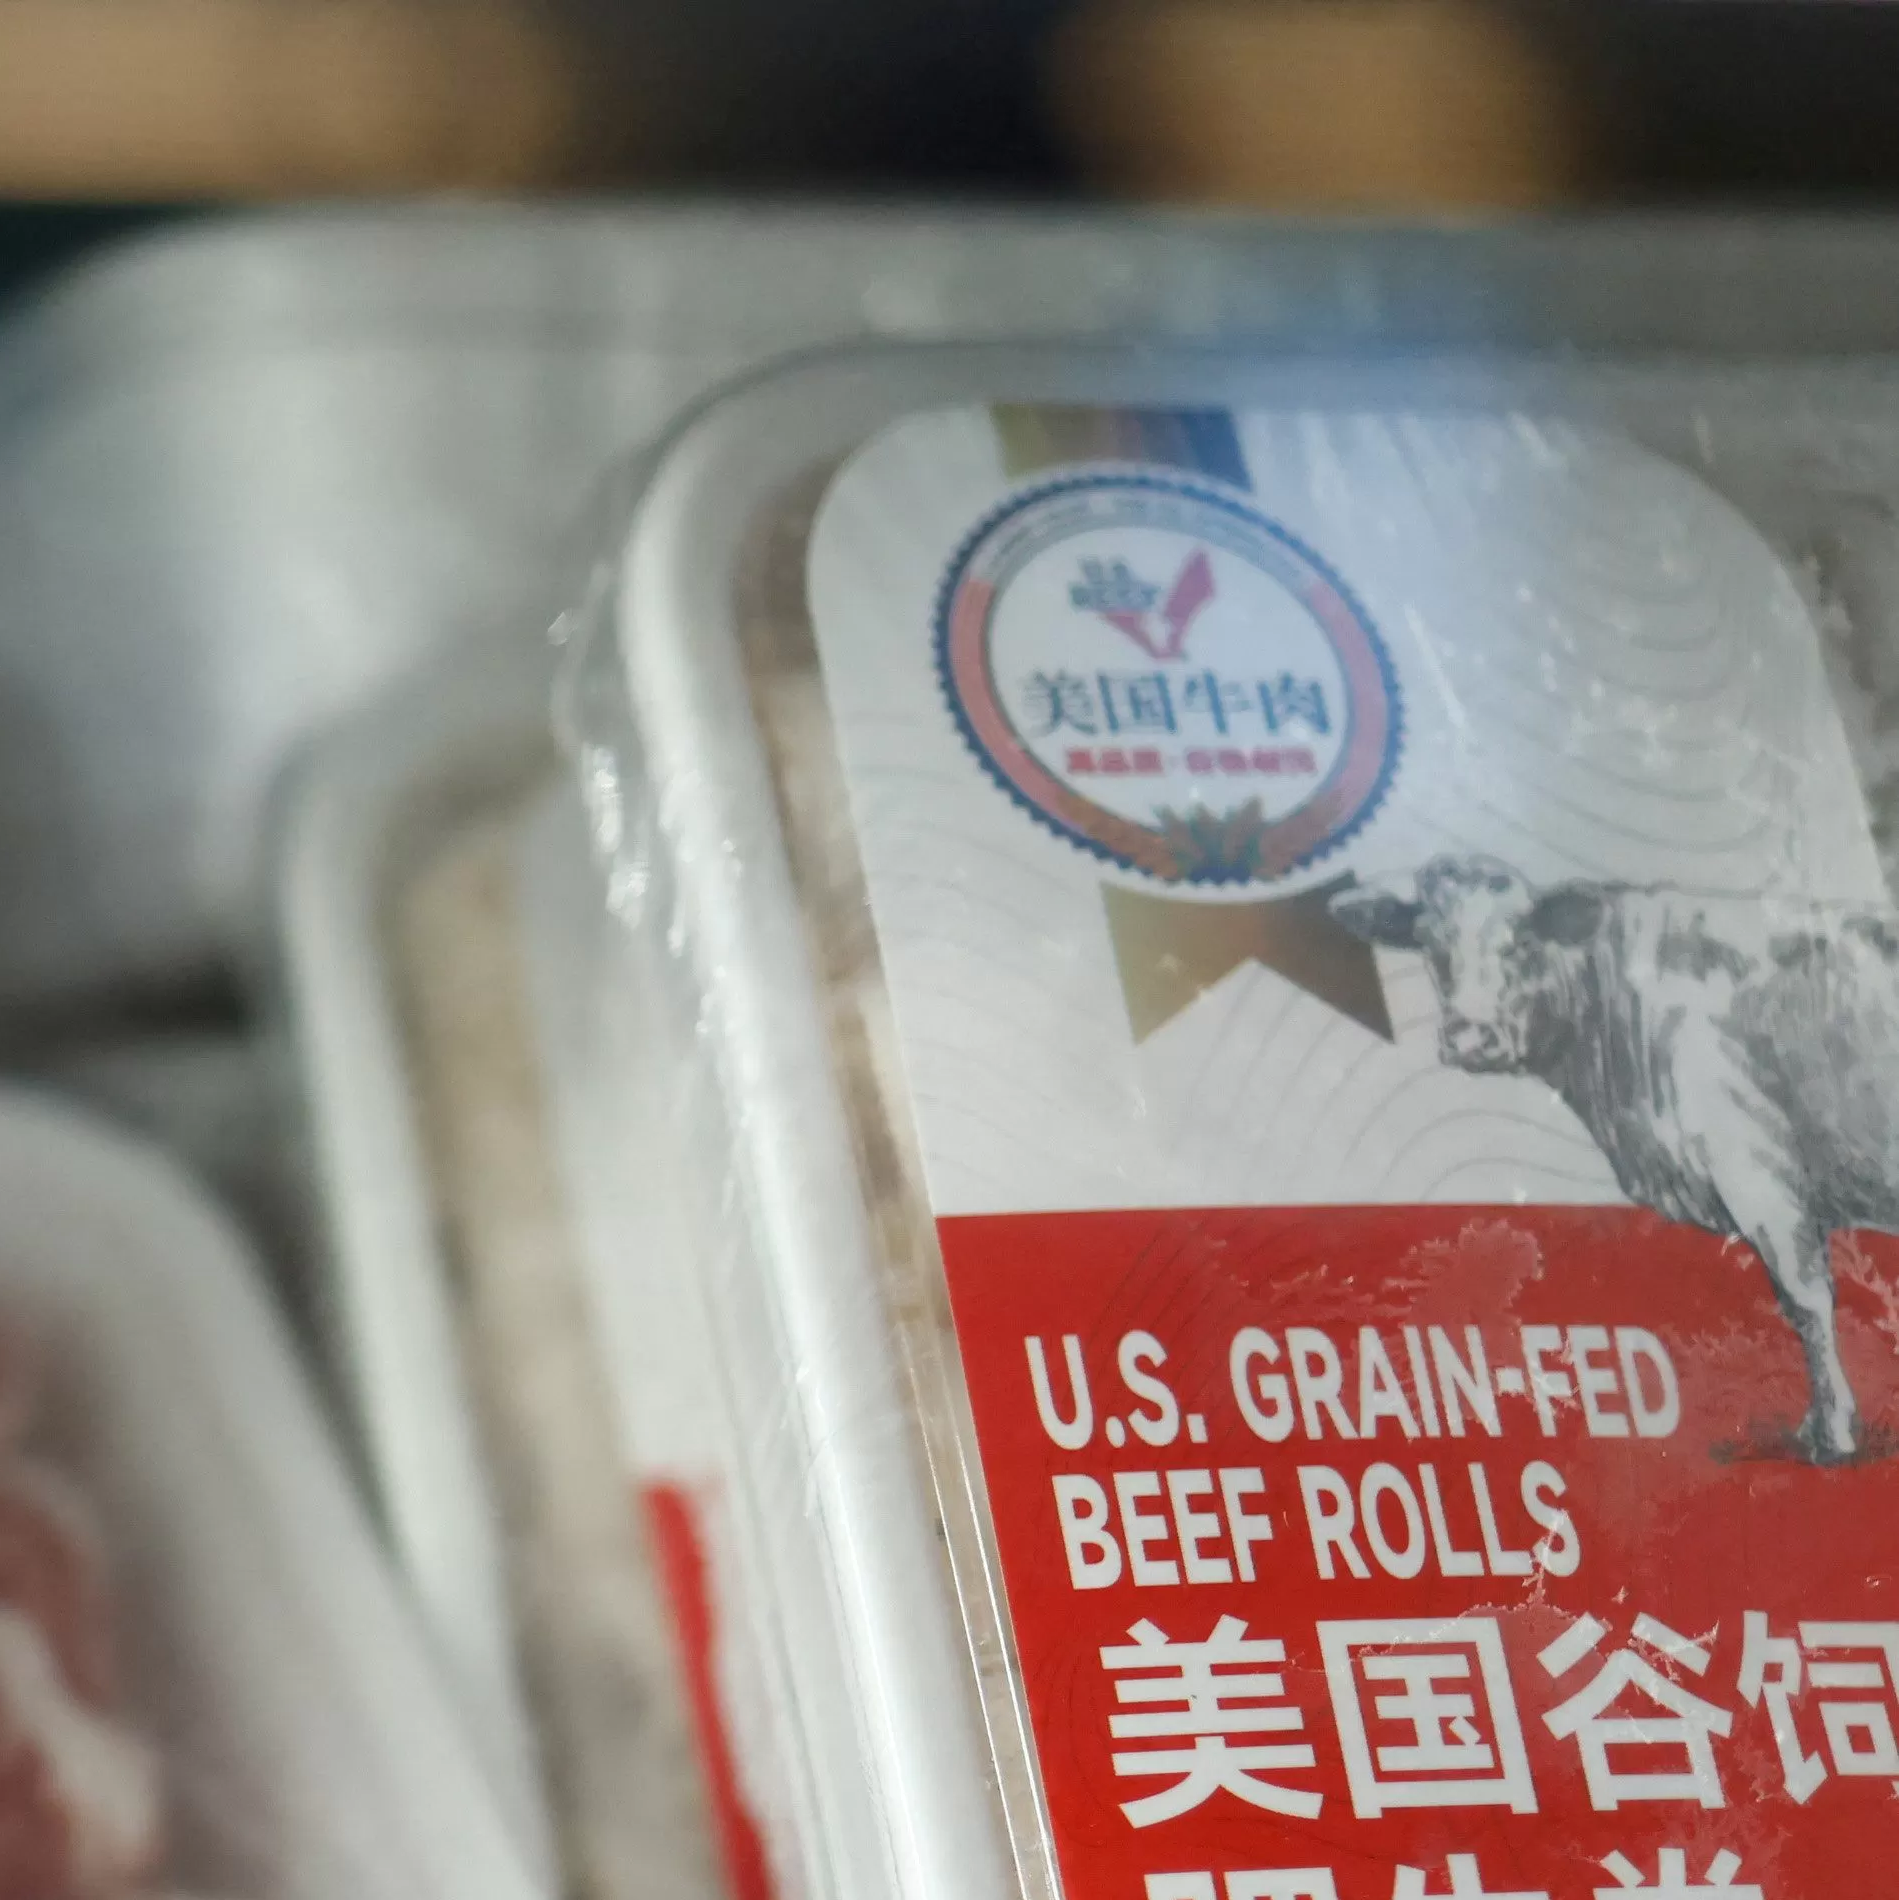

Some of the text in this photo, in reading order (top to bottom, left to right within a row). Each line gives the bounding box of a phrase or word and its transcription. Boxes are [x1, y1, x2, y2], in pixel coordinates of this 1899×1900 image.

[1024, 668, 1329, 736] 美国牛肉
[1025, 1325, 1681, 1449] U.S. GRAIN-FED
[1052, 1461, 1582, 1589] BEEF ROLLS
[1100, 1611, 1899, 1828] 美国谷饲
